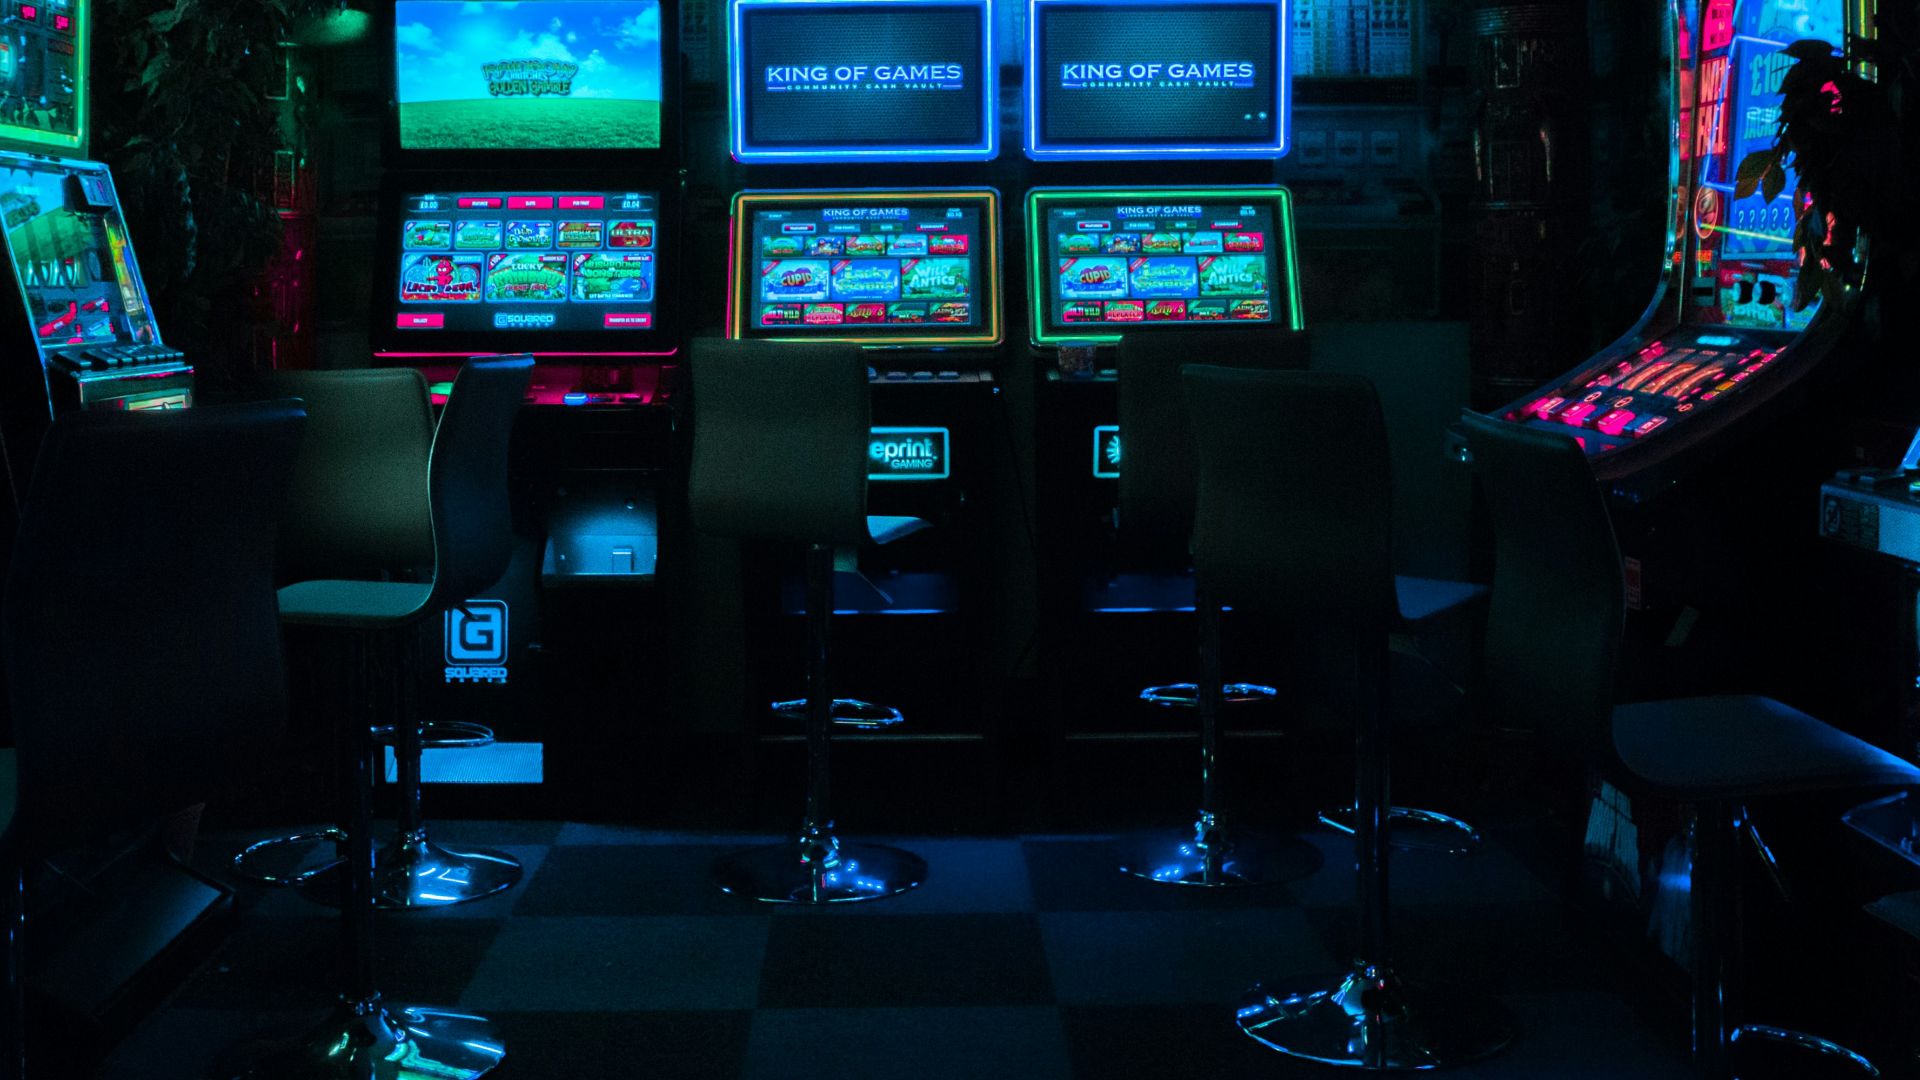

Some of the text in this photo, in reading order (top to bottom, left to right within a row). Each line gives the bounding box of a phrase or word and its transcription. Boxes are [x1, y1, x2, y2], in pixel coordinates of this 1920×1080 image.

[767, 64, 962, 83] KING OF GAMES
[1063, 62, 1254, 80] KING OF GAMES
[905, 82, 942, 90] VAULT
[1198, 80, 1235, 88] VAULT
[824, 207, 908, 217] KING OF GAMES
[1117, 207, 1144, 215] KING
[1146, 206, 1161, 215] OF
[1163, 205, 1202, 214] GAMES
[511, 262, 544, 271] LUCKY
[781, 271, 812, 288] CUPID
[910, 274, 956, 288] ANTICS
[1081, 269, 1112, 285] CUPID
[1208, 272, 1253, 285] ANTICS
[443, 280, 477, 293] DEVIL
[507, 314, 554, 323] SQUARED
[870, 438, 932, 462] eprint
[891, 459, 933, 469] GAMING
[445, 667, 507, 678] SQUARED
